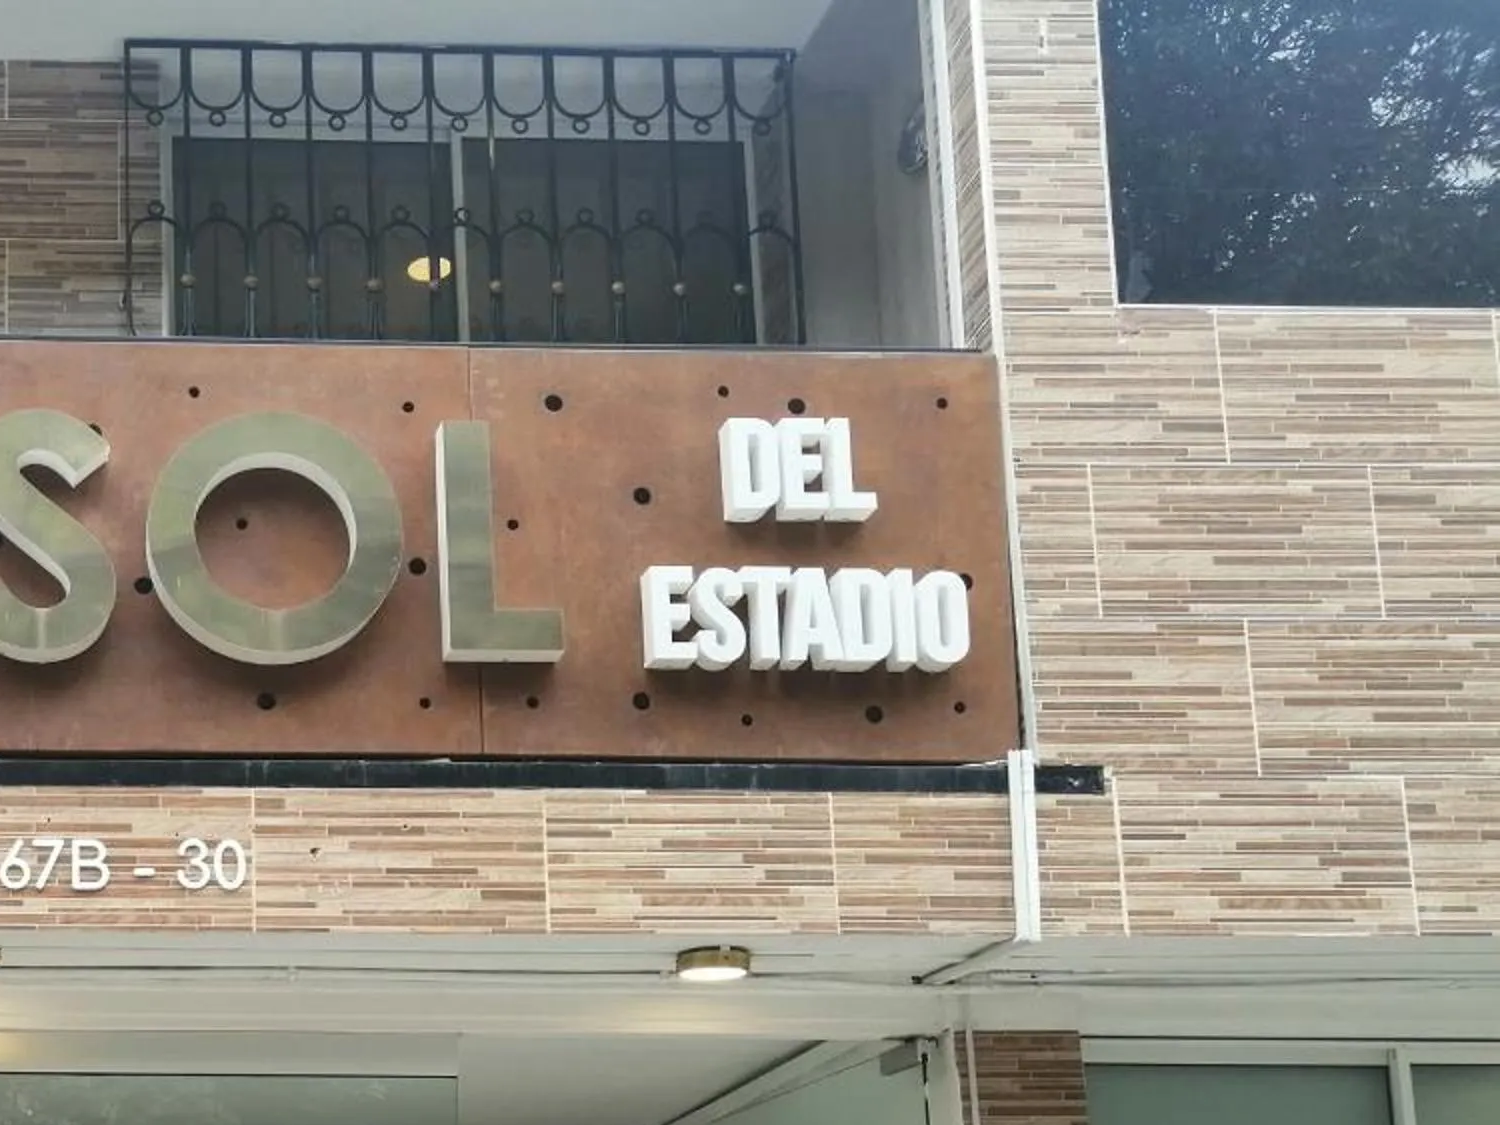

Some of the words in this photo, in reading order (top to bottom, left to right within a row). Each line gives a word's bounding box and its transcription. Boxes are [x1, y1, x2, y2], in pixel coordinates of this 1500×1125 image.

[717, 416, 878, 524] DEL
[640, 564, 972, 673] ESTADIO
[0, 838, 112, 892] 67B
[176, 838, 249, 893] 30
